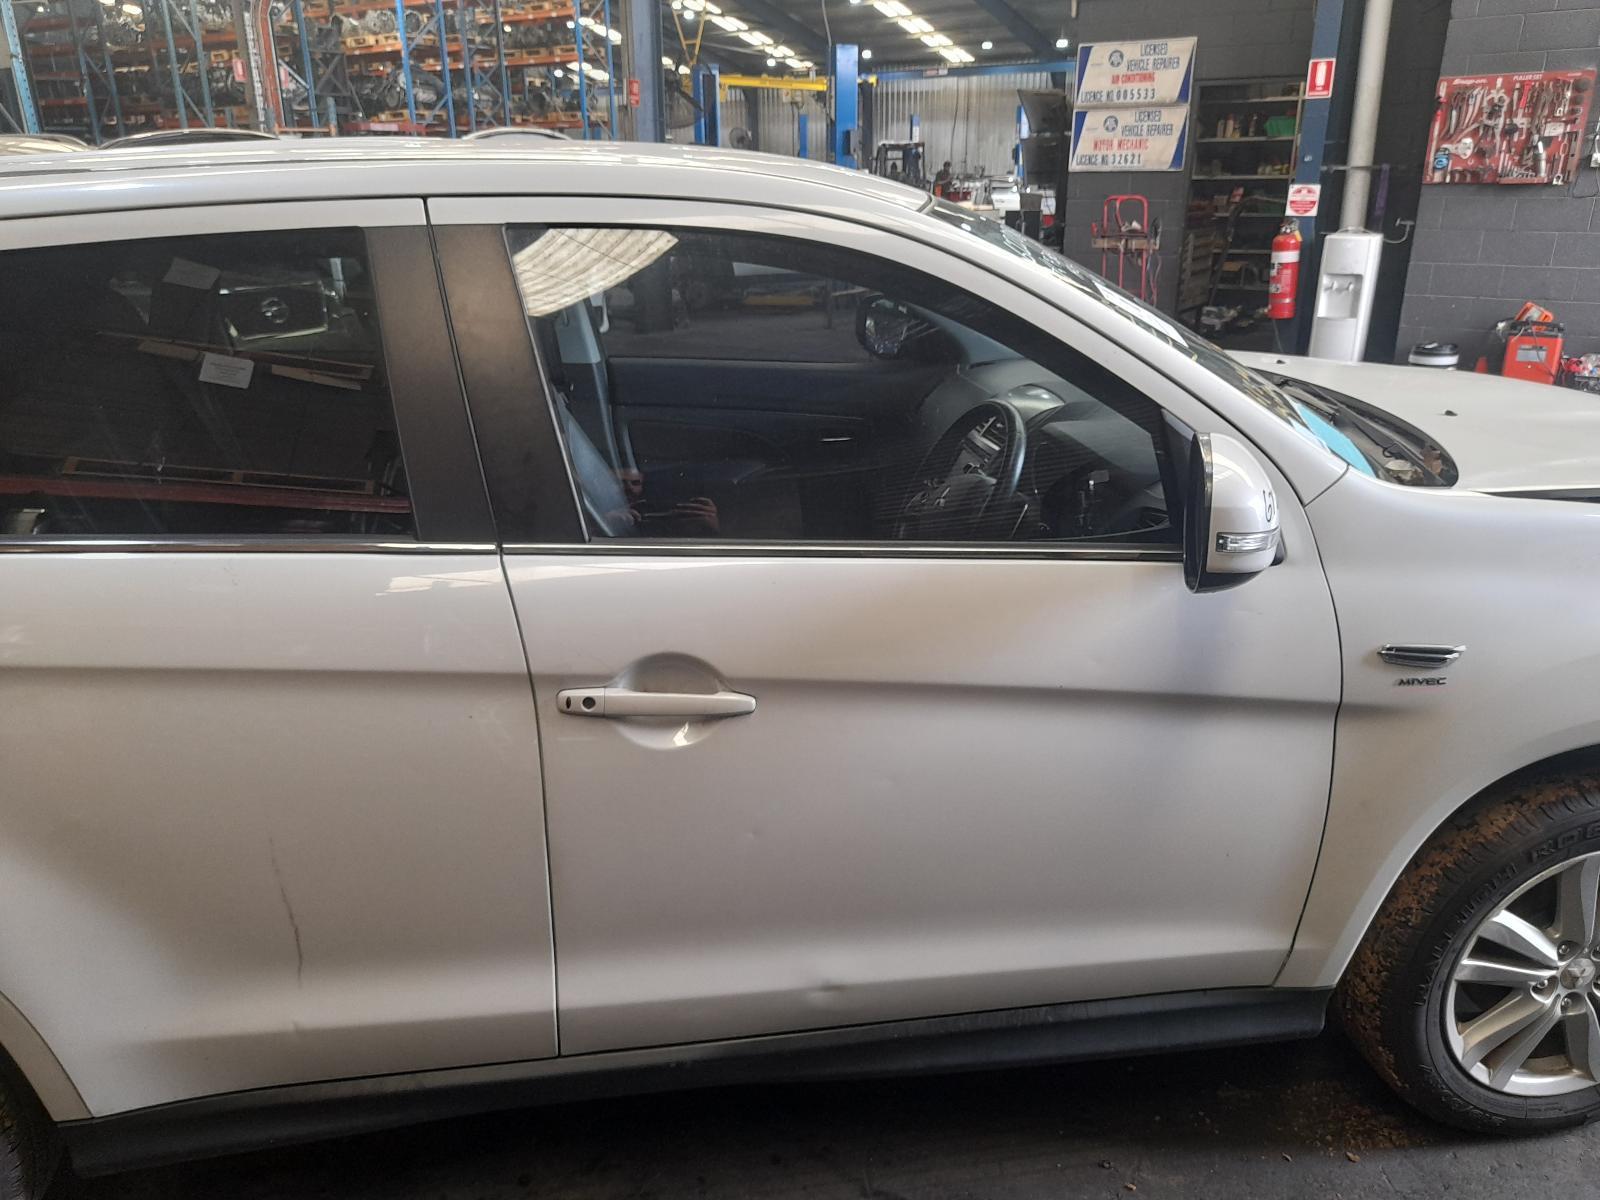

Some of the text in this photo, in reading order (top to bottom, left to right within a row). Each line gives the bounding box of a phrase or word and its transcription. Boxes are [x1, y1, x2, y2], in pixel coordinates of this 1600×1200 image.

[1140, 42, 1168, 56] LICENSED
[1127, 56, 1180, 71] VEHICLE REPAIRER
[1111, 72, 1155, 84] AIR CONDITIONING
[1080, 91, 1103, 103] LICENCE
[1116, 88, 1156, 101] 005533
[1135, 110, 1162, 123] LICENSED
[1121, 123, 1173, 137] VEHICLE REPAIRER
[1093, 138, 1149, 151] MOTOR MECHANIC
[1076, 154, 1098, 166] LICENCE
[1111, 153, 1142, 165] 32621
[1398, 676, 1447, 687] MIVEC
